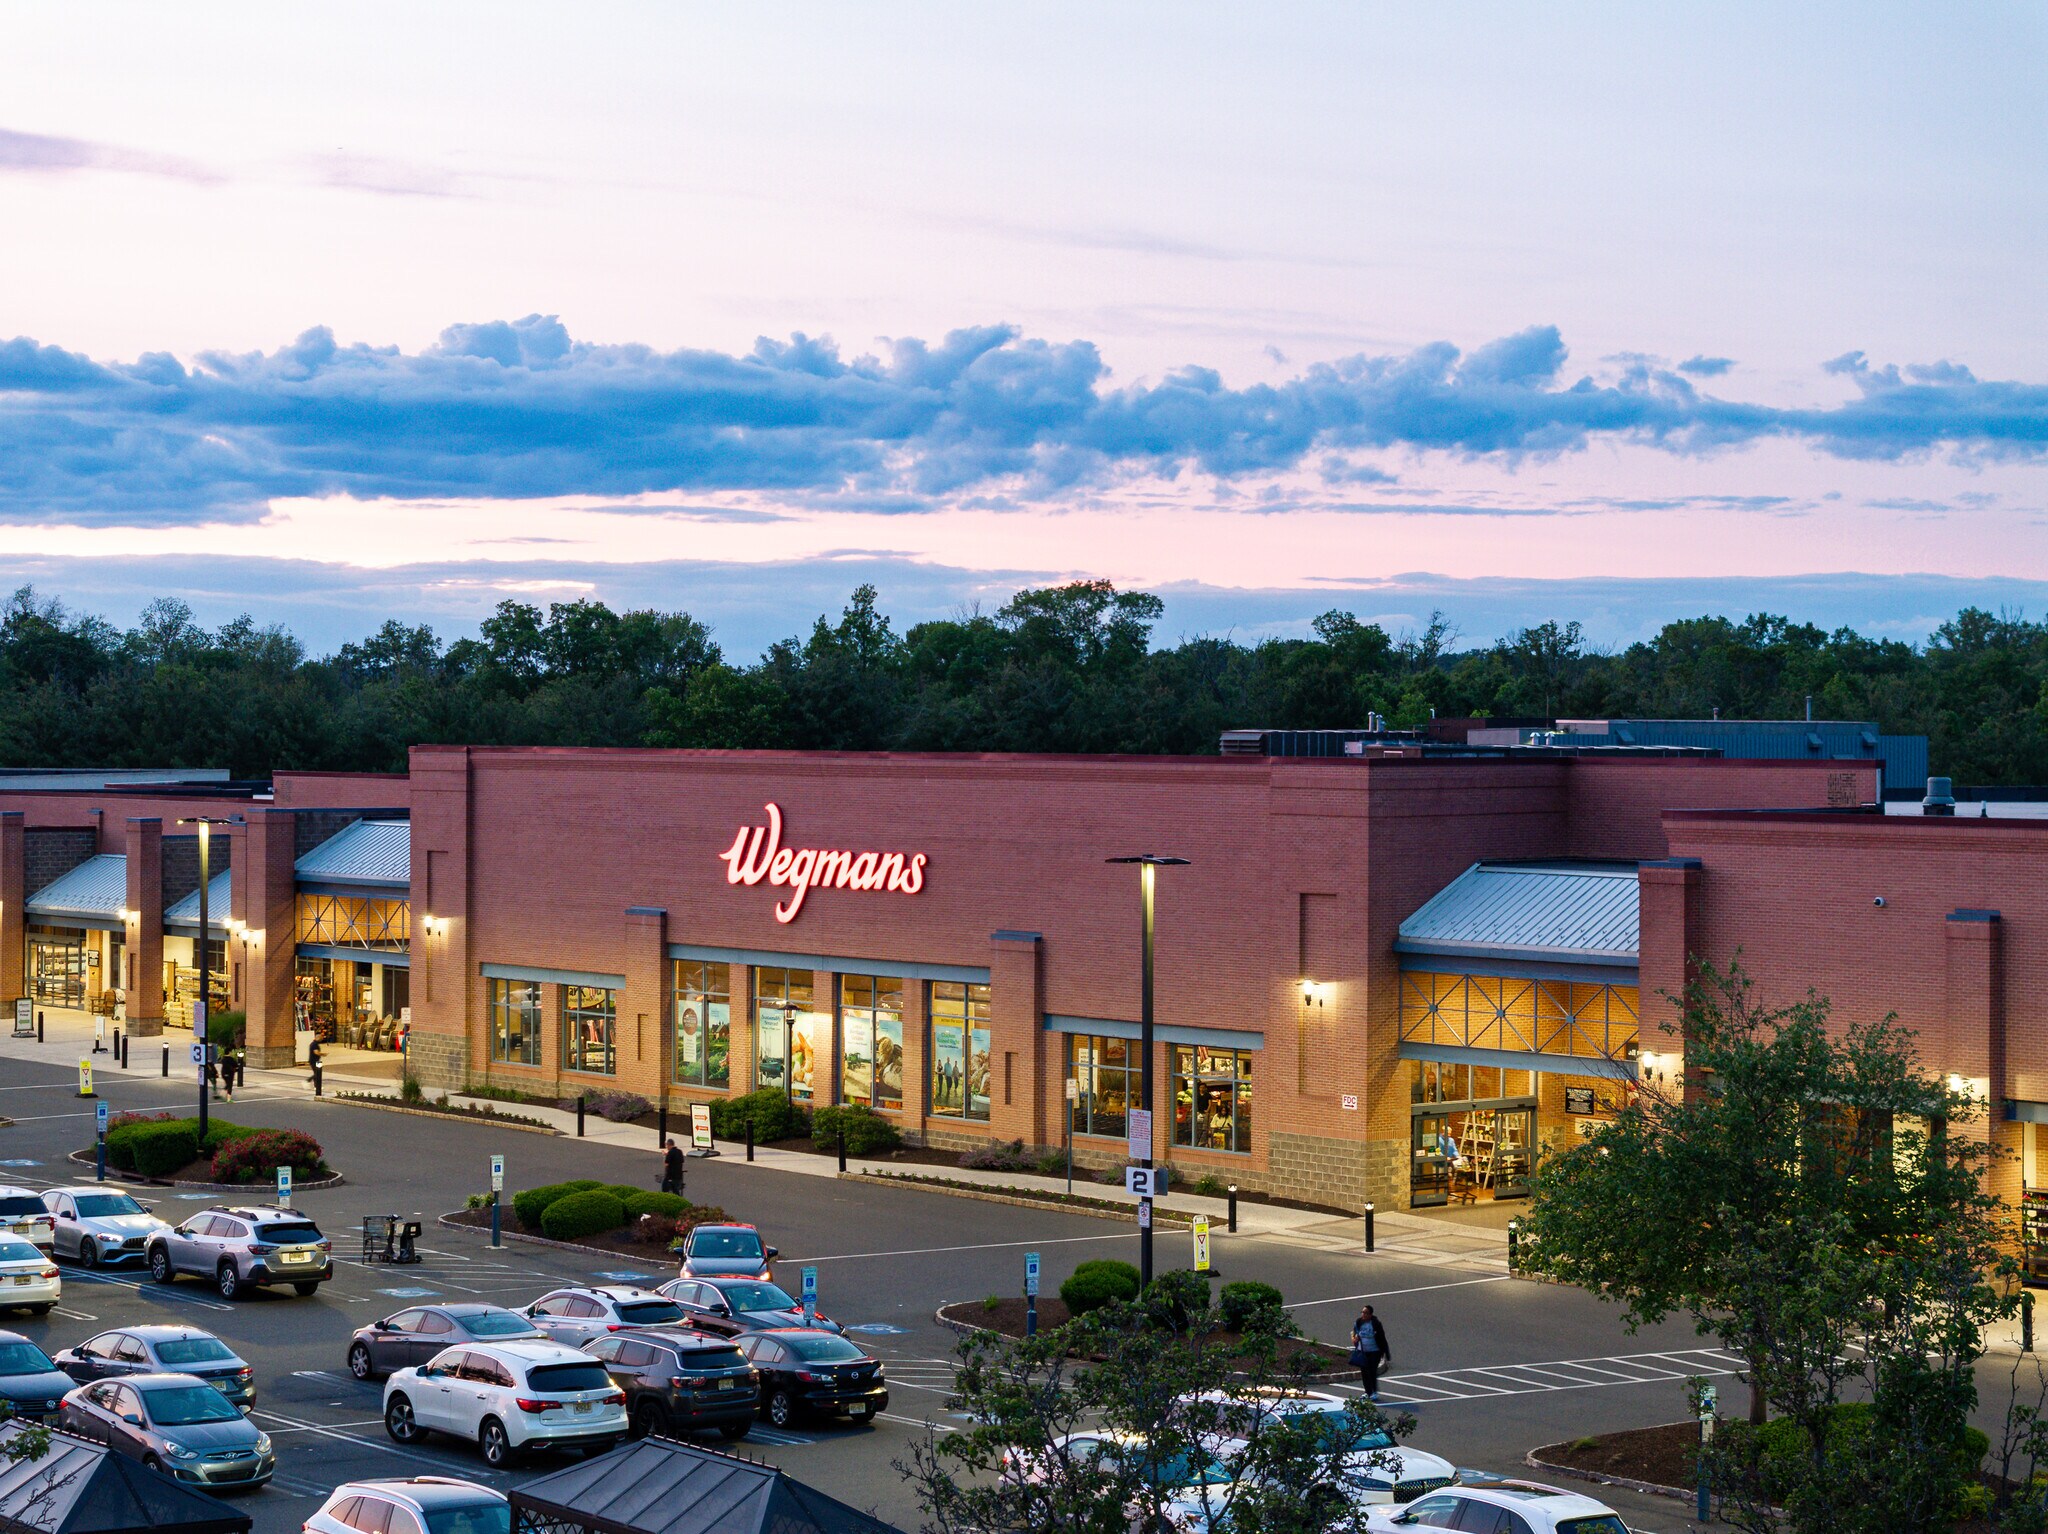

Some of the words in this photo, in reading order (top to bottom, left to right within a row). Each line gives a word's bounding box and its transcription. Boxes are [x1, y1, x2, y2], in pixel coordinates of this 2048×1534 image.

[718, 802, 927, 924] Wegmans
[193, 1045, 202, 1062] 3
[1343, 1095, 1357, 1105] FDC
[1132, 1170, 1148, 1194] 2
